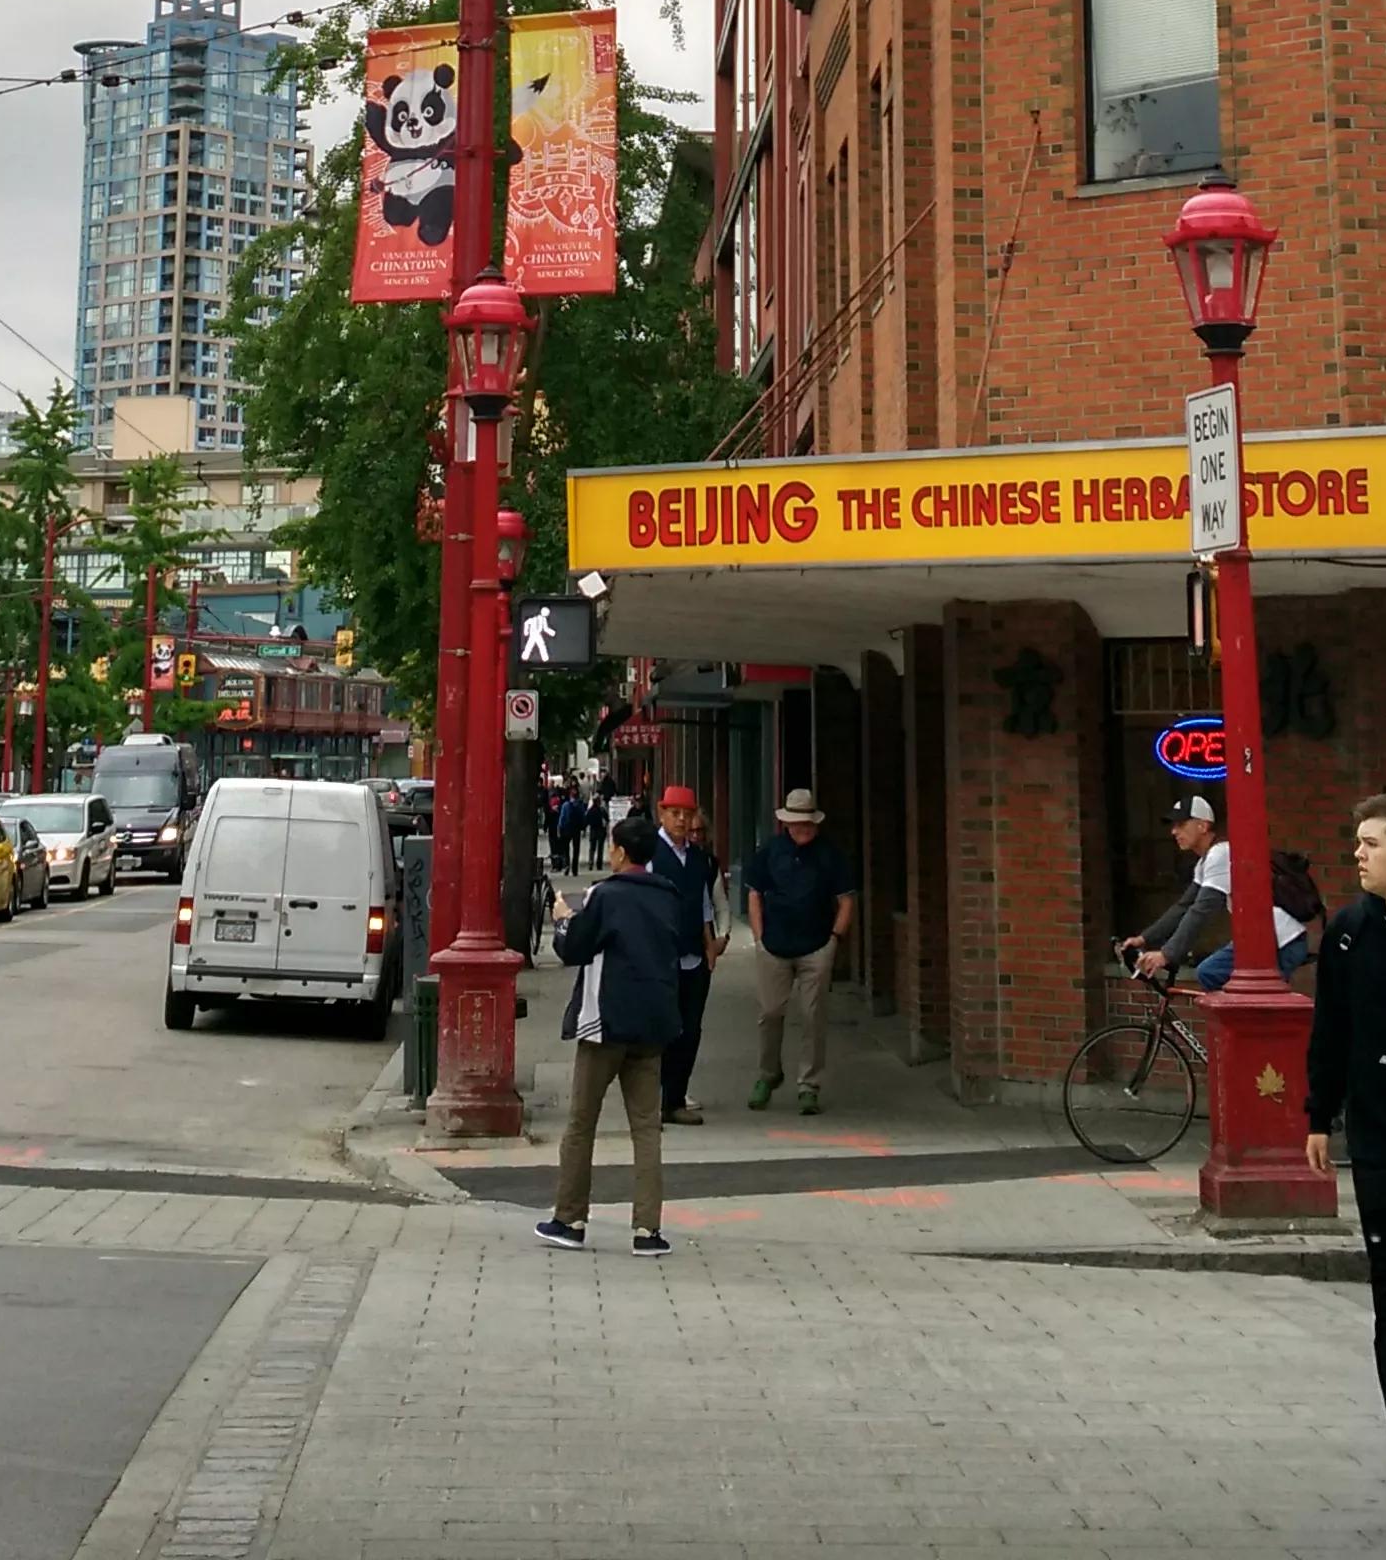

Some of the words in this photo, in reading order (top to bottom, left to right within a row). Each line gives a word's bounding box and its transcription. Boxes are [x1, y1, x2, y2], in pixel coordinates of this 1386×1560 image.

[533, 242, 591, 252] VANCOUVER
[382, 250, 439, 259] VANCOUVER
[523, 251, 602, 265] CHINATOWN
[370, 259, 447, 273] CHINATOWN
[384, 277, 408, 286] SINCE
[537, 270, 562, 279] SINCE
[1194, 406, 1229, 442] BEGIN
[1200, 451, 1226, 485] ONE
[628, 481, 818, 549] BEIJING
[837, 488, 901, 531] THE
[912, 481, 1060, 528] CHINESE
[1073, 474, 1191, 523] HERBA
[1201, 499, 1227, 533] WAY
[1161, 730, 1226, 762] OPE
